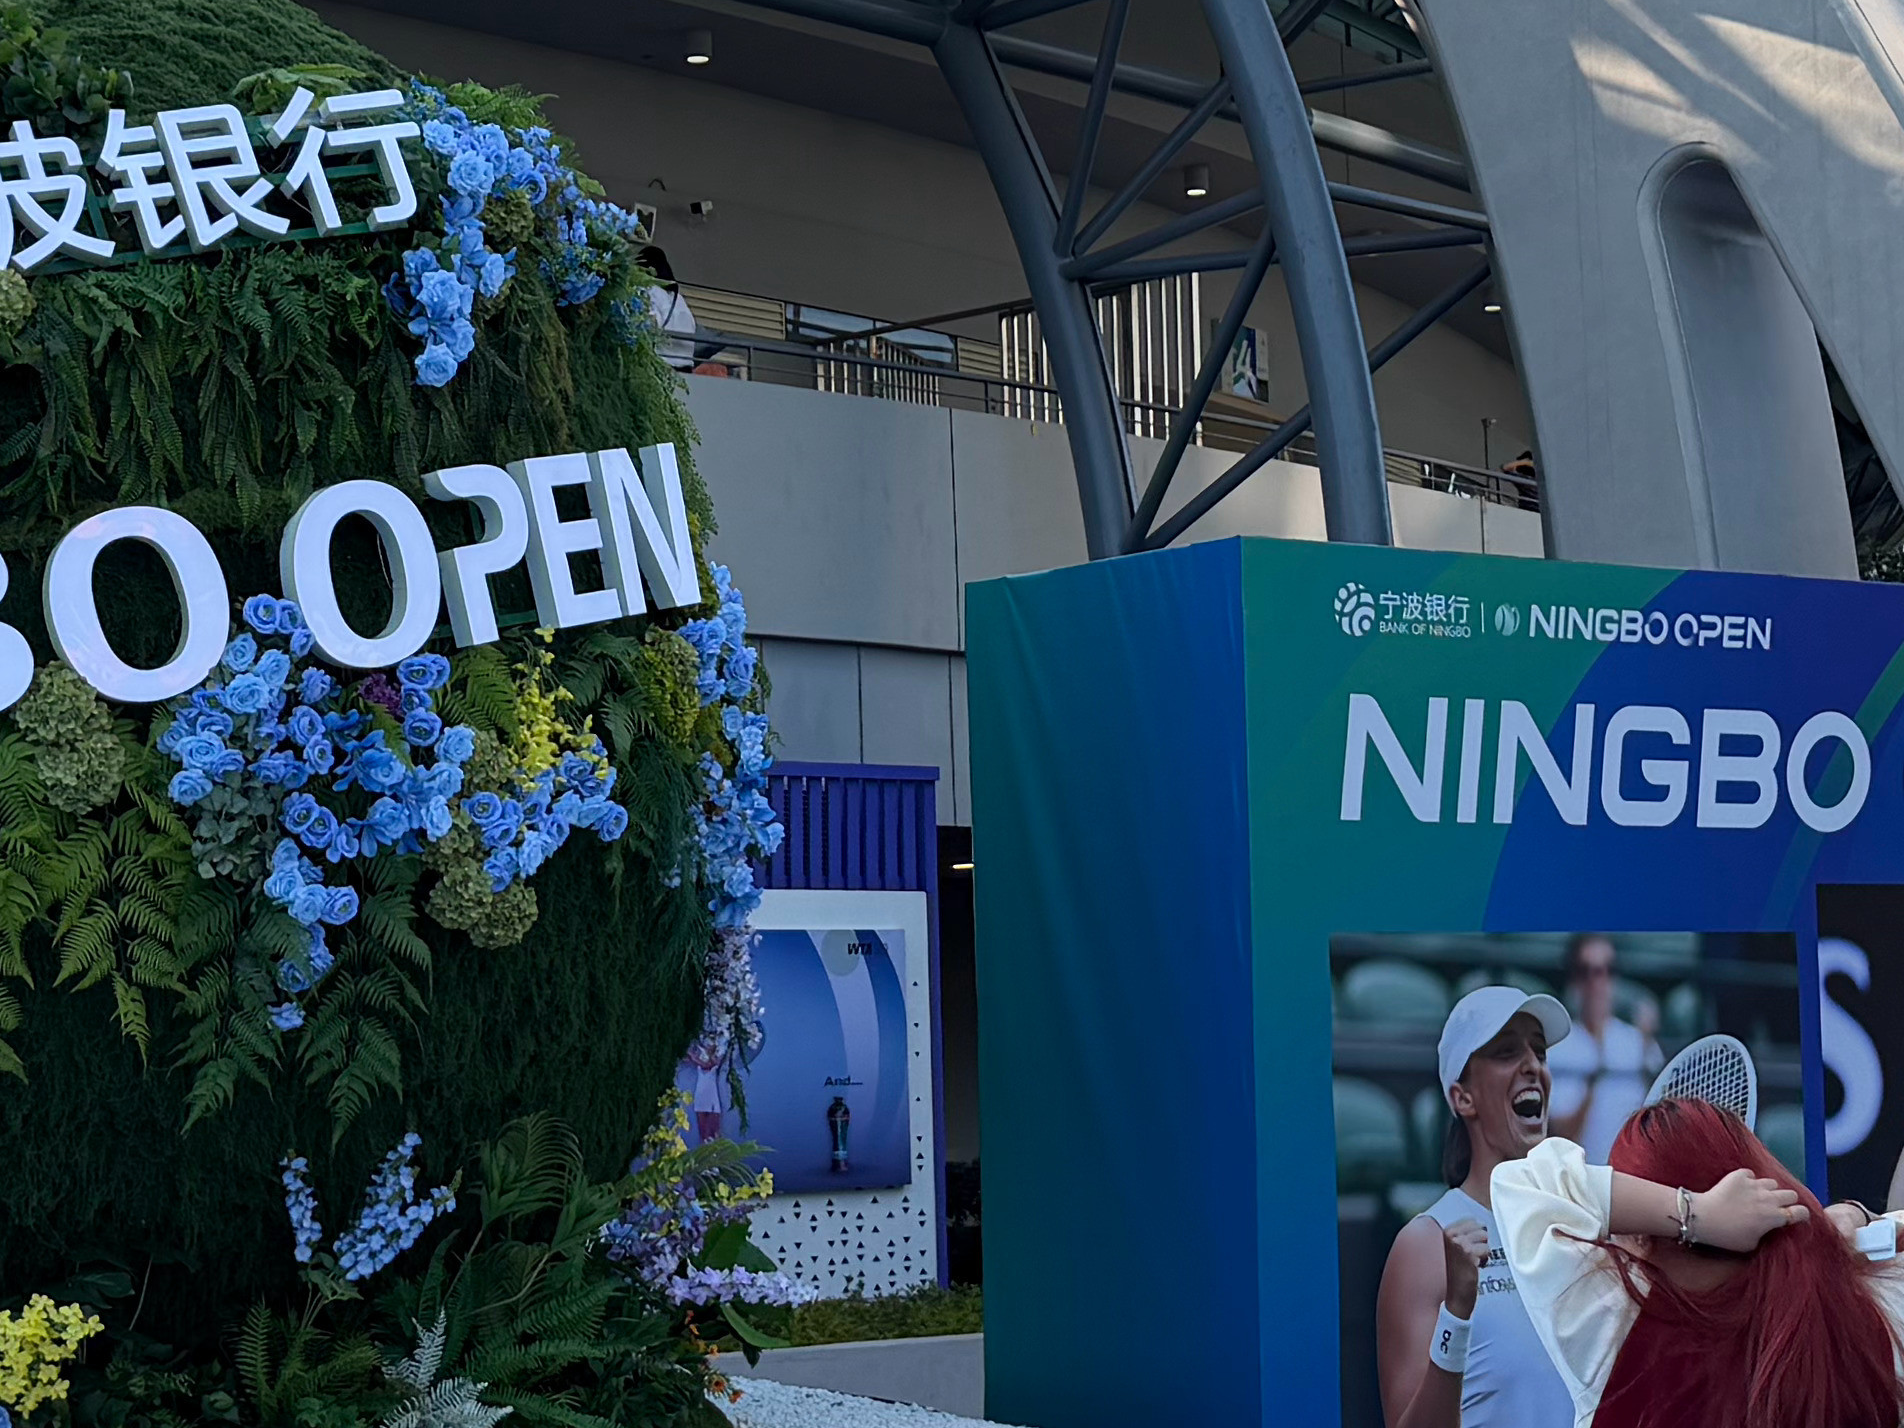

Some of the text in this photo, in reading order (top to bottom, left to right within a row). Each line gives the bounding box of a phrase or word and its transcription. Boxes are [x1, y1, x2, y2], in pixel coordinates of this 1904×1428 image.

[273, 439, 705, 672] OPEN
[1378, 590, 1471, 624] 宁波银行
[1379, 621, 1471, 639] BANK OF NINGBO
[1528, 603, 1773, 651] NINGBO OPEN
[1339, 692, 1873, 835] NINGBO
